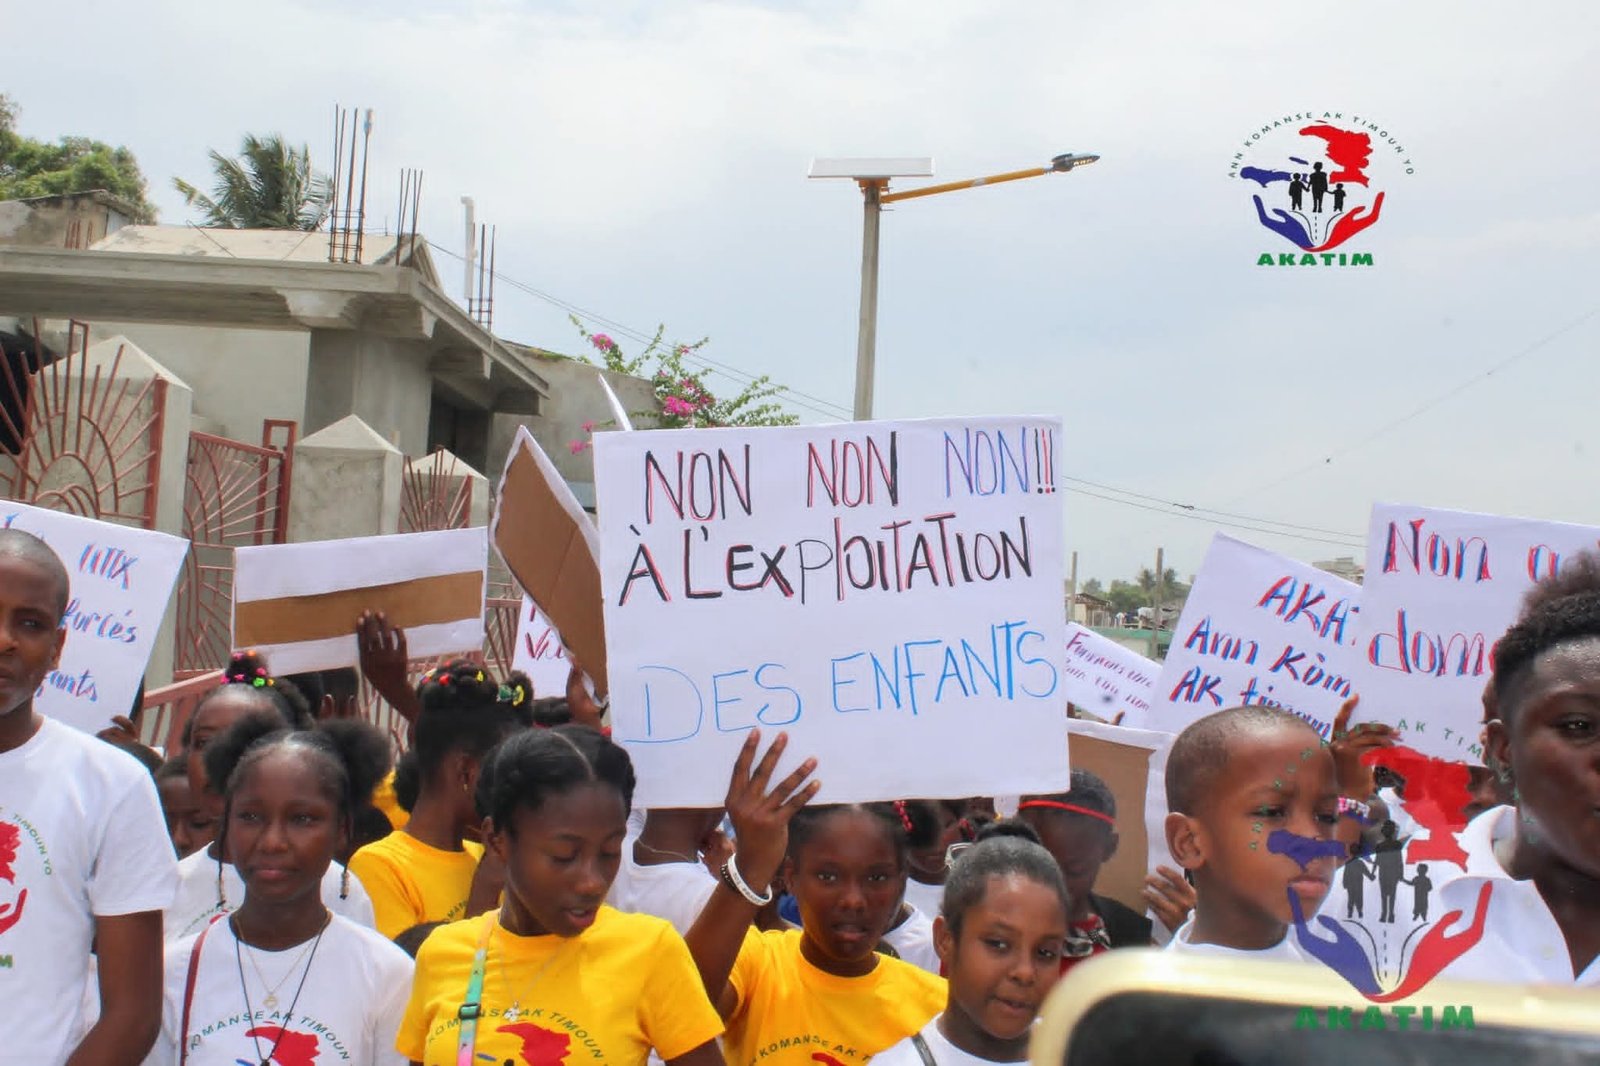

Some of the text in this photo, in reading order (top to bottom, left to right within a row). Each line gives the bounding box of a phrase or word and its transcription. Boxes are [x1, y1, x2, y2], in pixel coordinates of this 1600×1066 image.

[644, 444, 752, 524] NON
[807, 431, 898, 507] NON
[619, 525, 671, 606] À
[1383, 519, 1493, 584] Non
[1184, 614, 1259, 665] Ann
[620, 663, 802, 743] DES
[831, 621, 1058, 715] ENFANTS
[1169, 665, 1224, 706] AK
[13, 803, 47, 855] TIMOUN
[301, 1017, 350, 1060] TIMOUN
[521, 1008, 546, 1018] AK
[549, 1012, 605, 1059] TIMOUN
[759, 1034, 857, 1057] KOMANSE AK
